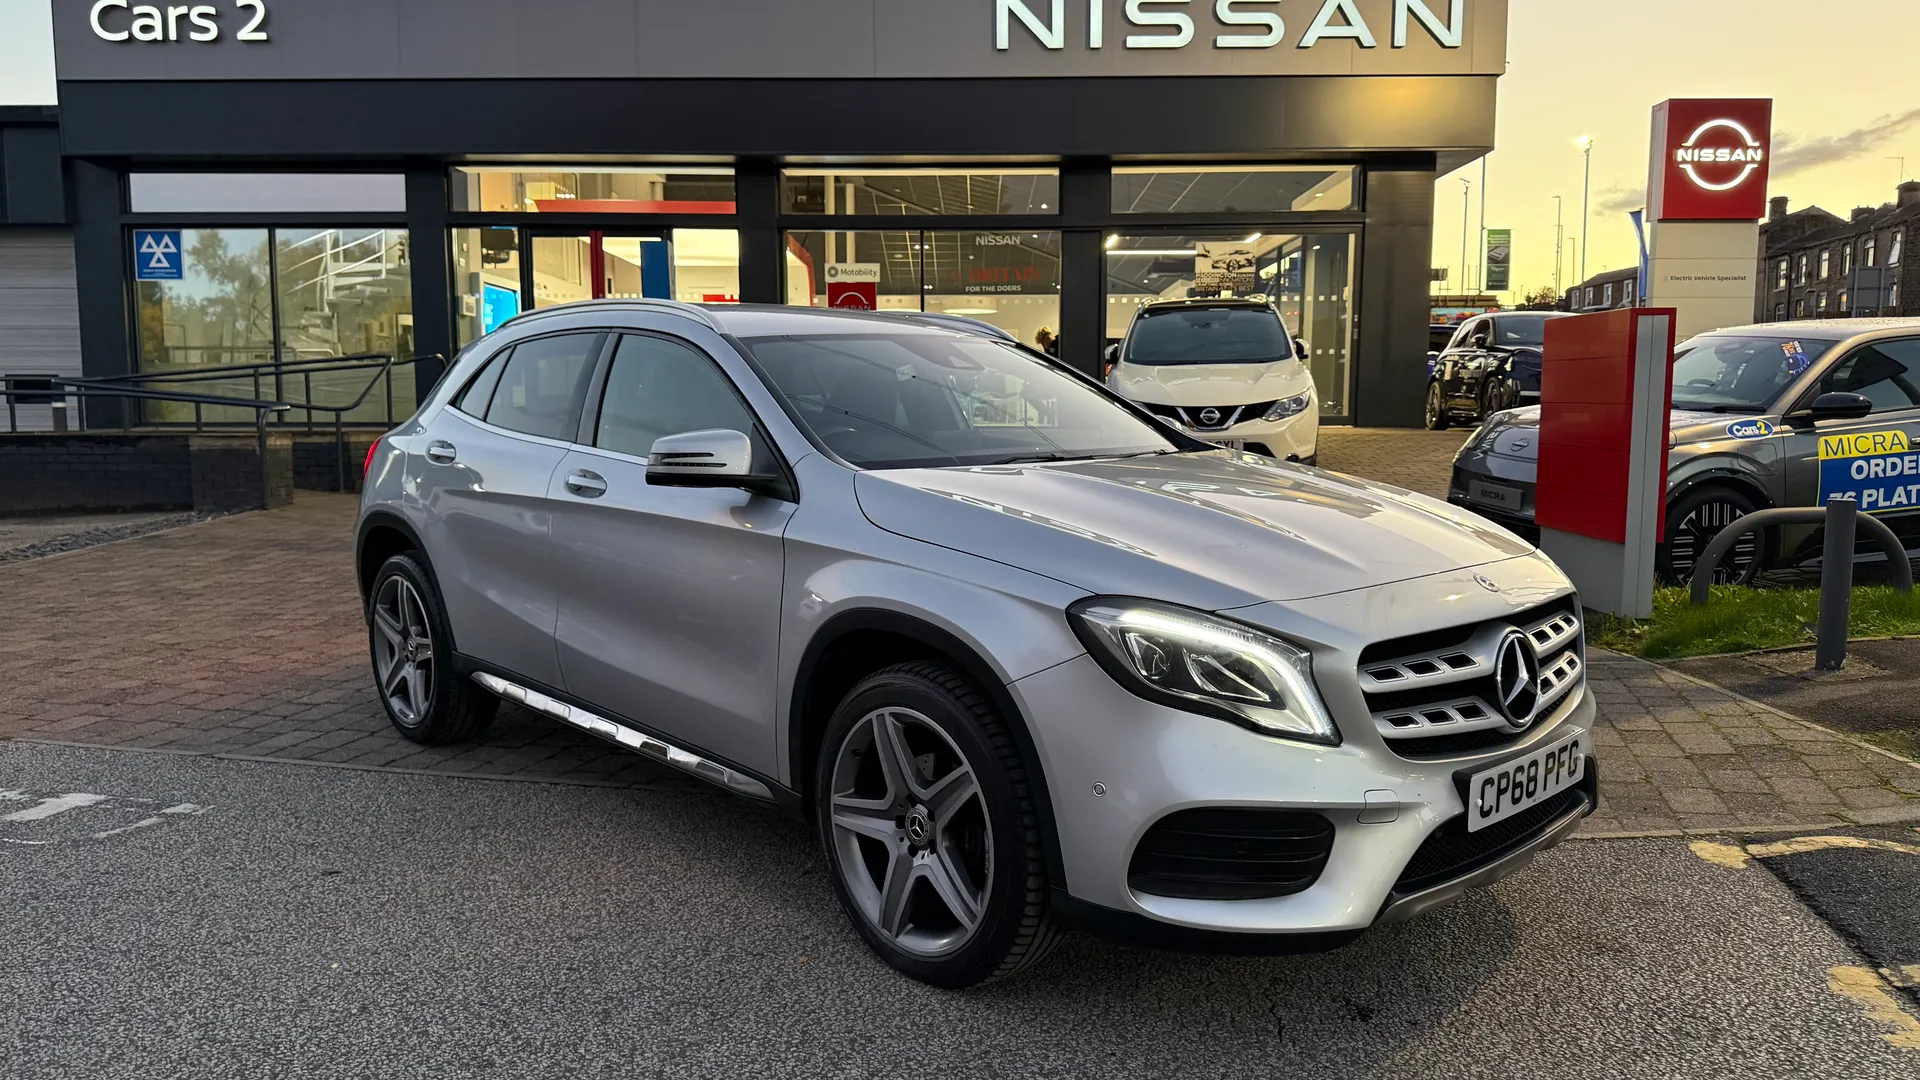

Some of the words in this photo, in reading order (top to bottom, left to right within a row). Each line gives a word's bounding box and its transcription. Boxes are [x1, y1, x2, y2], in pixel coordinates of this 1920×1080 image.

[90, 0, 219, 42] Cars
[236, 0, 268, 41] 2
[995, 0, 1463, 50] NISSAN
[1677, 148, 1762, 162] NISSAN
[975, 235, 1021, 246] NISSAN
[840, 268, 878, 278] Motobility
[969, 266, 1041, 283] BRITAIN
[965, 285, 980, 293] FOR
[997, 284, 1022, 292] DOERS
[1823, 432, 1906, 457] MICRA
[1850, 454, 1920, 480] ORDE
[1480, 488, 1506, 501] MICRA
[1479, 758, 1540, 819] CP68
[1542, 739, 1580, 792] PFG
